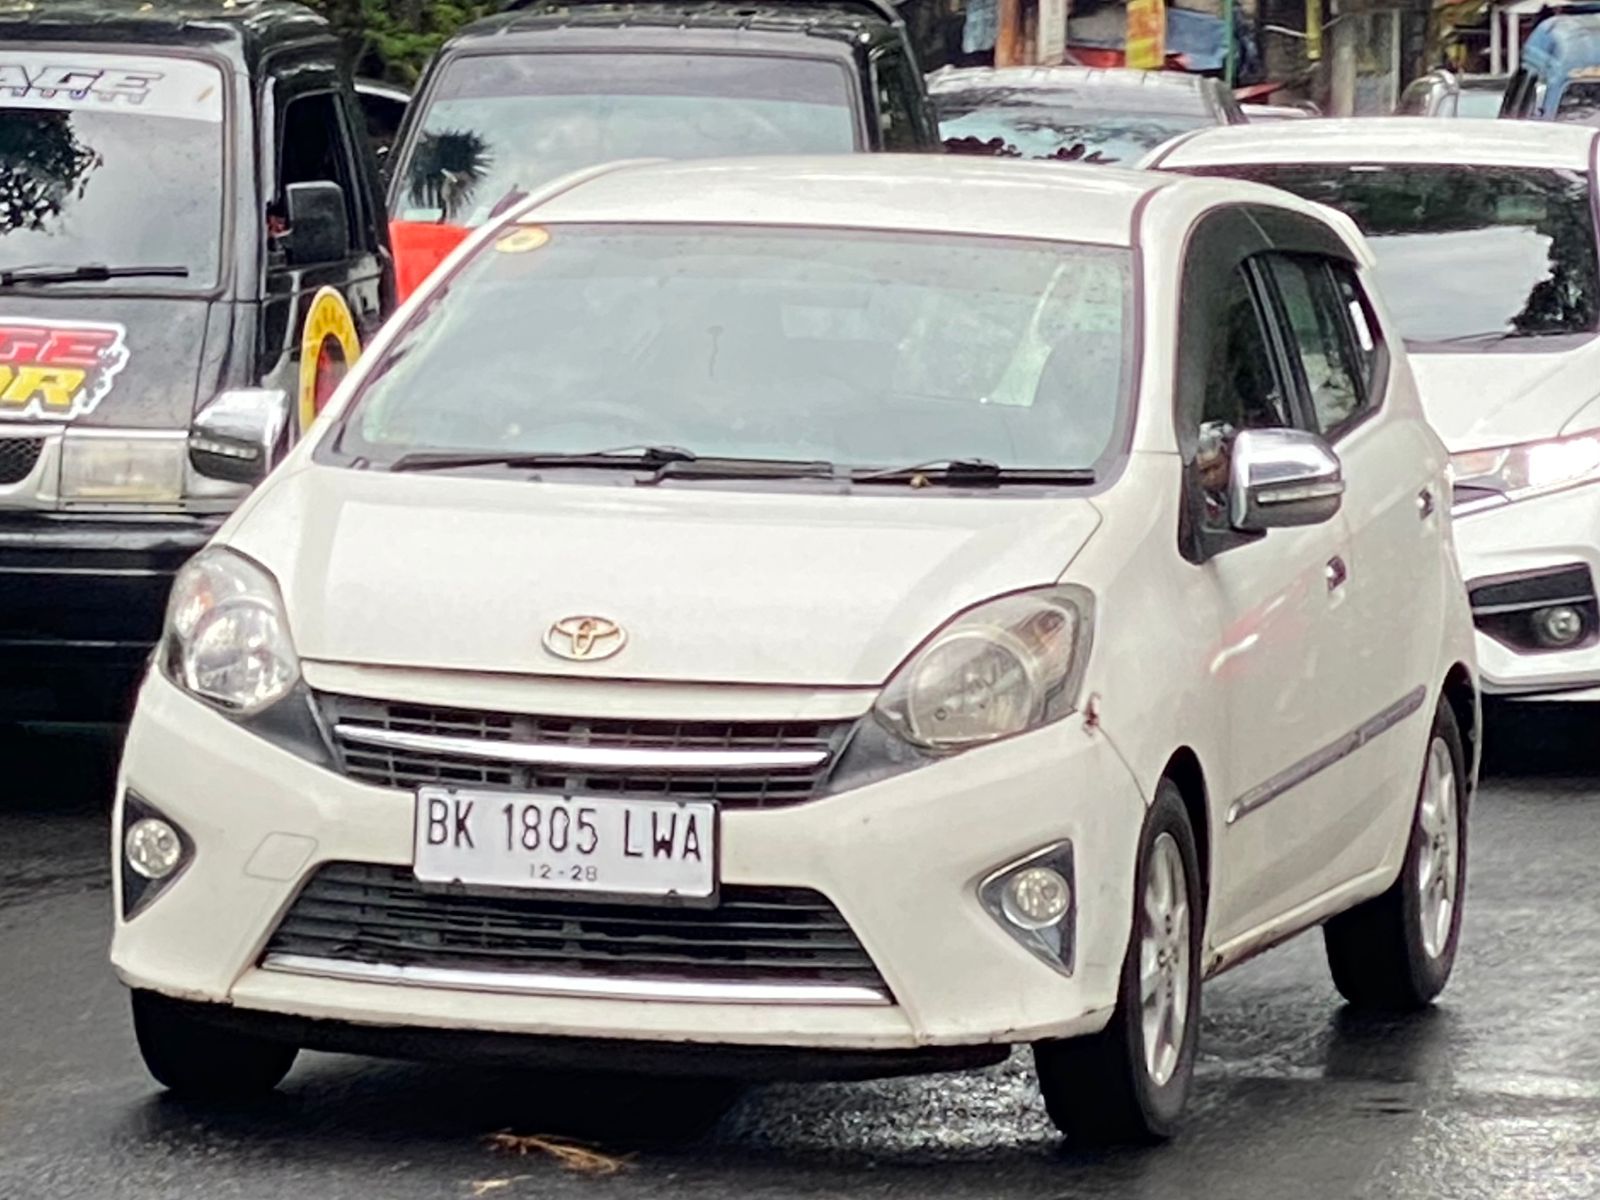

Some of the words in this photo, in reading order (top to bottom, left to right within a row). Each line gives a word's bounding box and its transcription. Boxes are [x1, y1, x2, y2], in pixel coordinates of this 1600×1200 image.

[0, 364, 86, 405] R
[427, 798, 474, 848] BK
[503, 803, 598, 853] 1805
[623, 810, 702, 862] LWA
